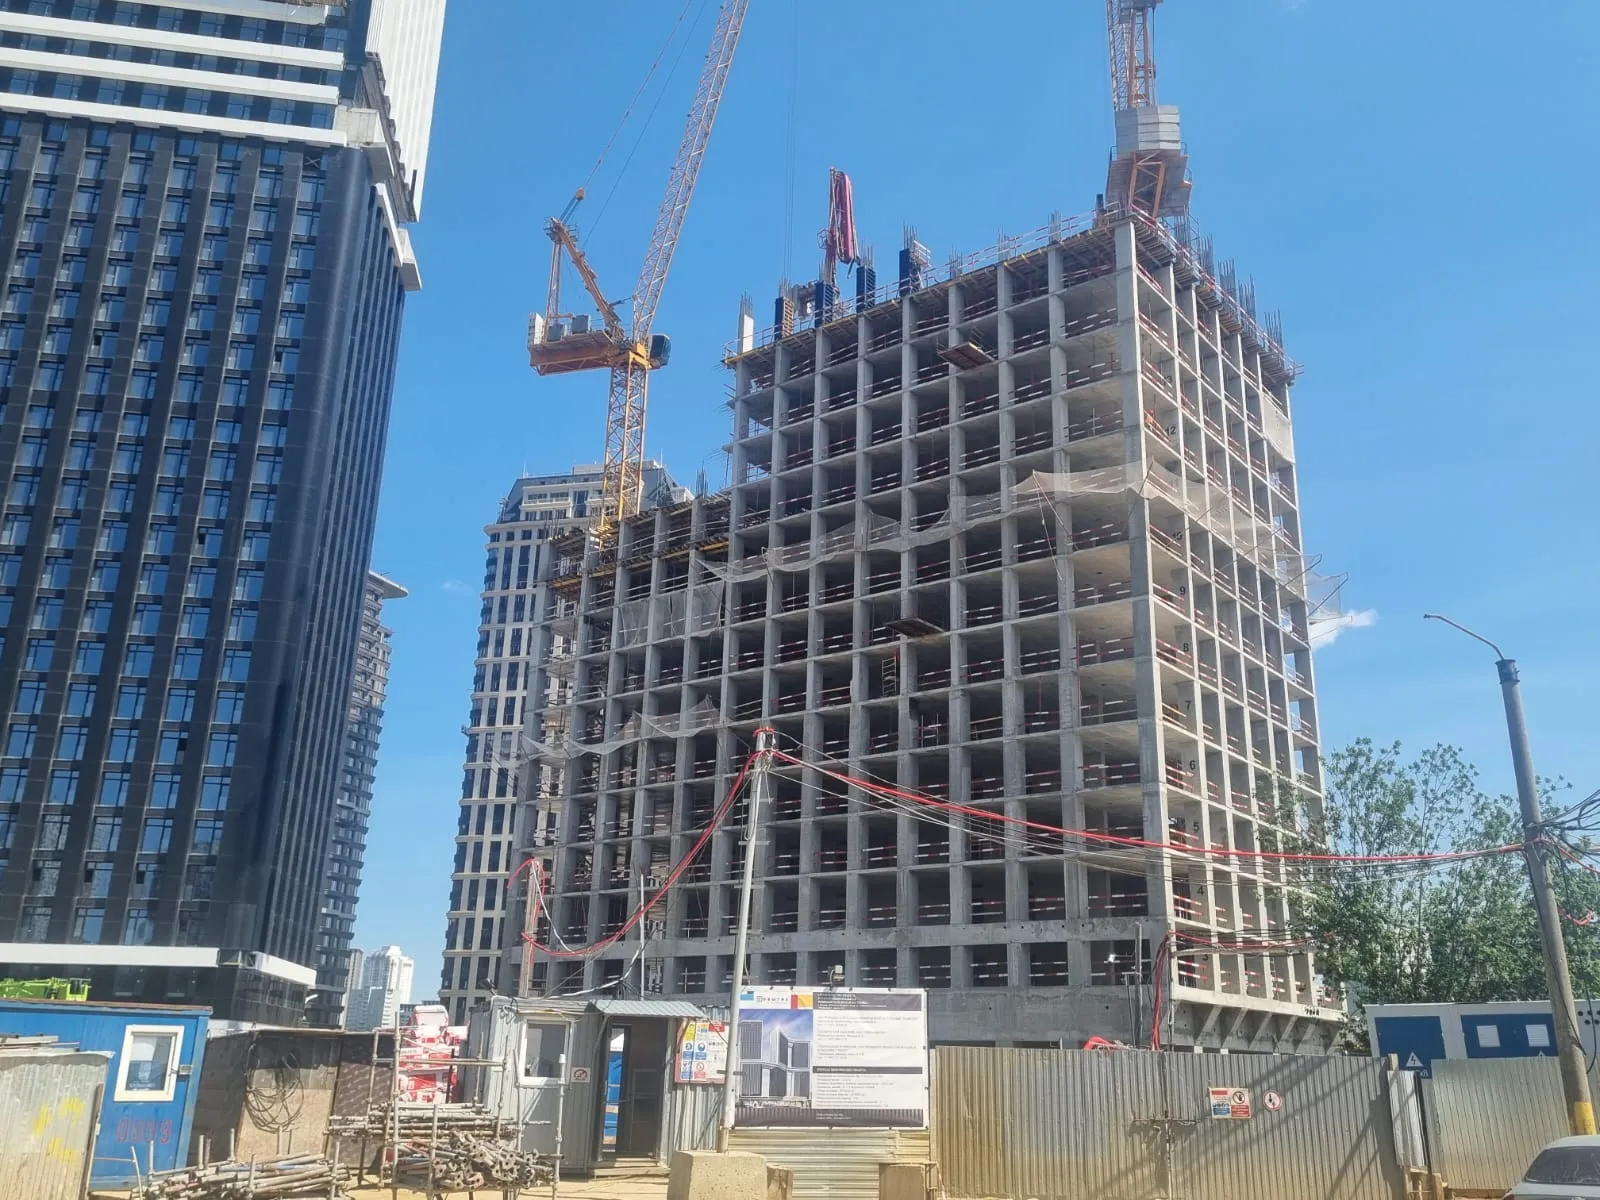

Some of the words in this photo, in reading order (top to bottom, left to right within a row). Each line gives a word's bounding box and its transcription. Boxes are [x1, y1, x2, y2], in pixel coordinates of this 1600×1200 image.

[1166, 425, 1176, 436] 12
[1179, 585, 1186, 595] 9
[1183, 642, 1189, 652] 8
[1184, 699, 1191, 710] 7
[1190, 760, 1196, 770] 6
[1193, 821, 1200, 832] 5
[1197, 885, 1204, 895] 4
